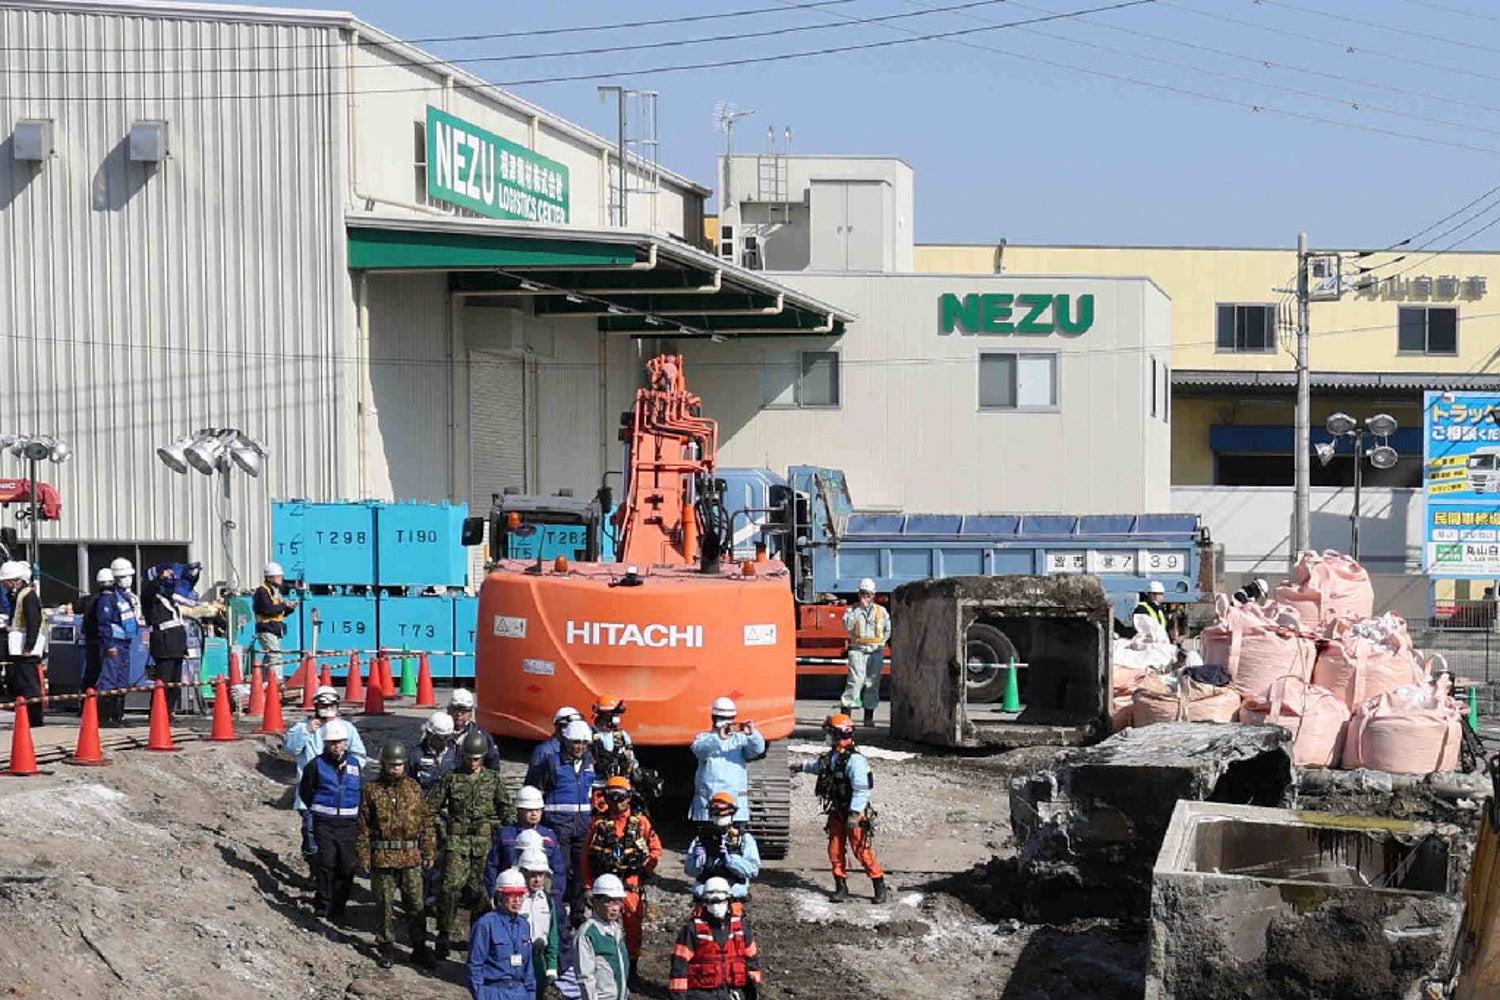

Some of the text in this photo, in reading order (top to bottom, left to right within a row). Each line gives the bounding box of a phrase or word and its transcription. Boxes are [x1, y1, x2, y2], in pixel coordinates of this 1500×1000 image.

[436, 120, 495, 206] NEZU
[499, 182, 565, 224] LOGISTICS CENTER
[1357, 274, 1487, 301] 丸山自動車
[938, 293, 1095, 338] NEZU
[316, 531, 366, 544] T298
[396, 530, 437, 543] T190
[399, 624, 435, 638] T73
[566, 620, 703, 648] HITACHI
